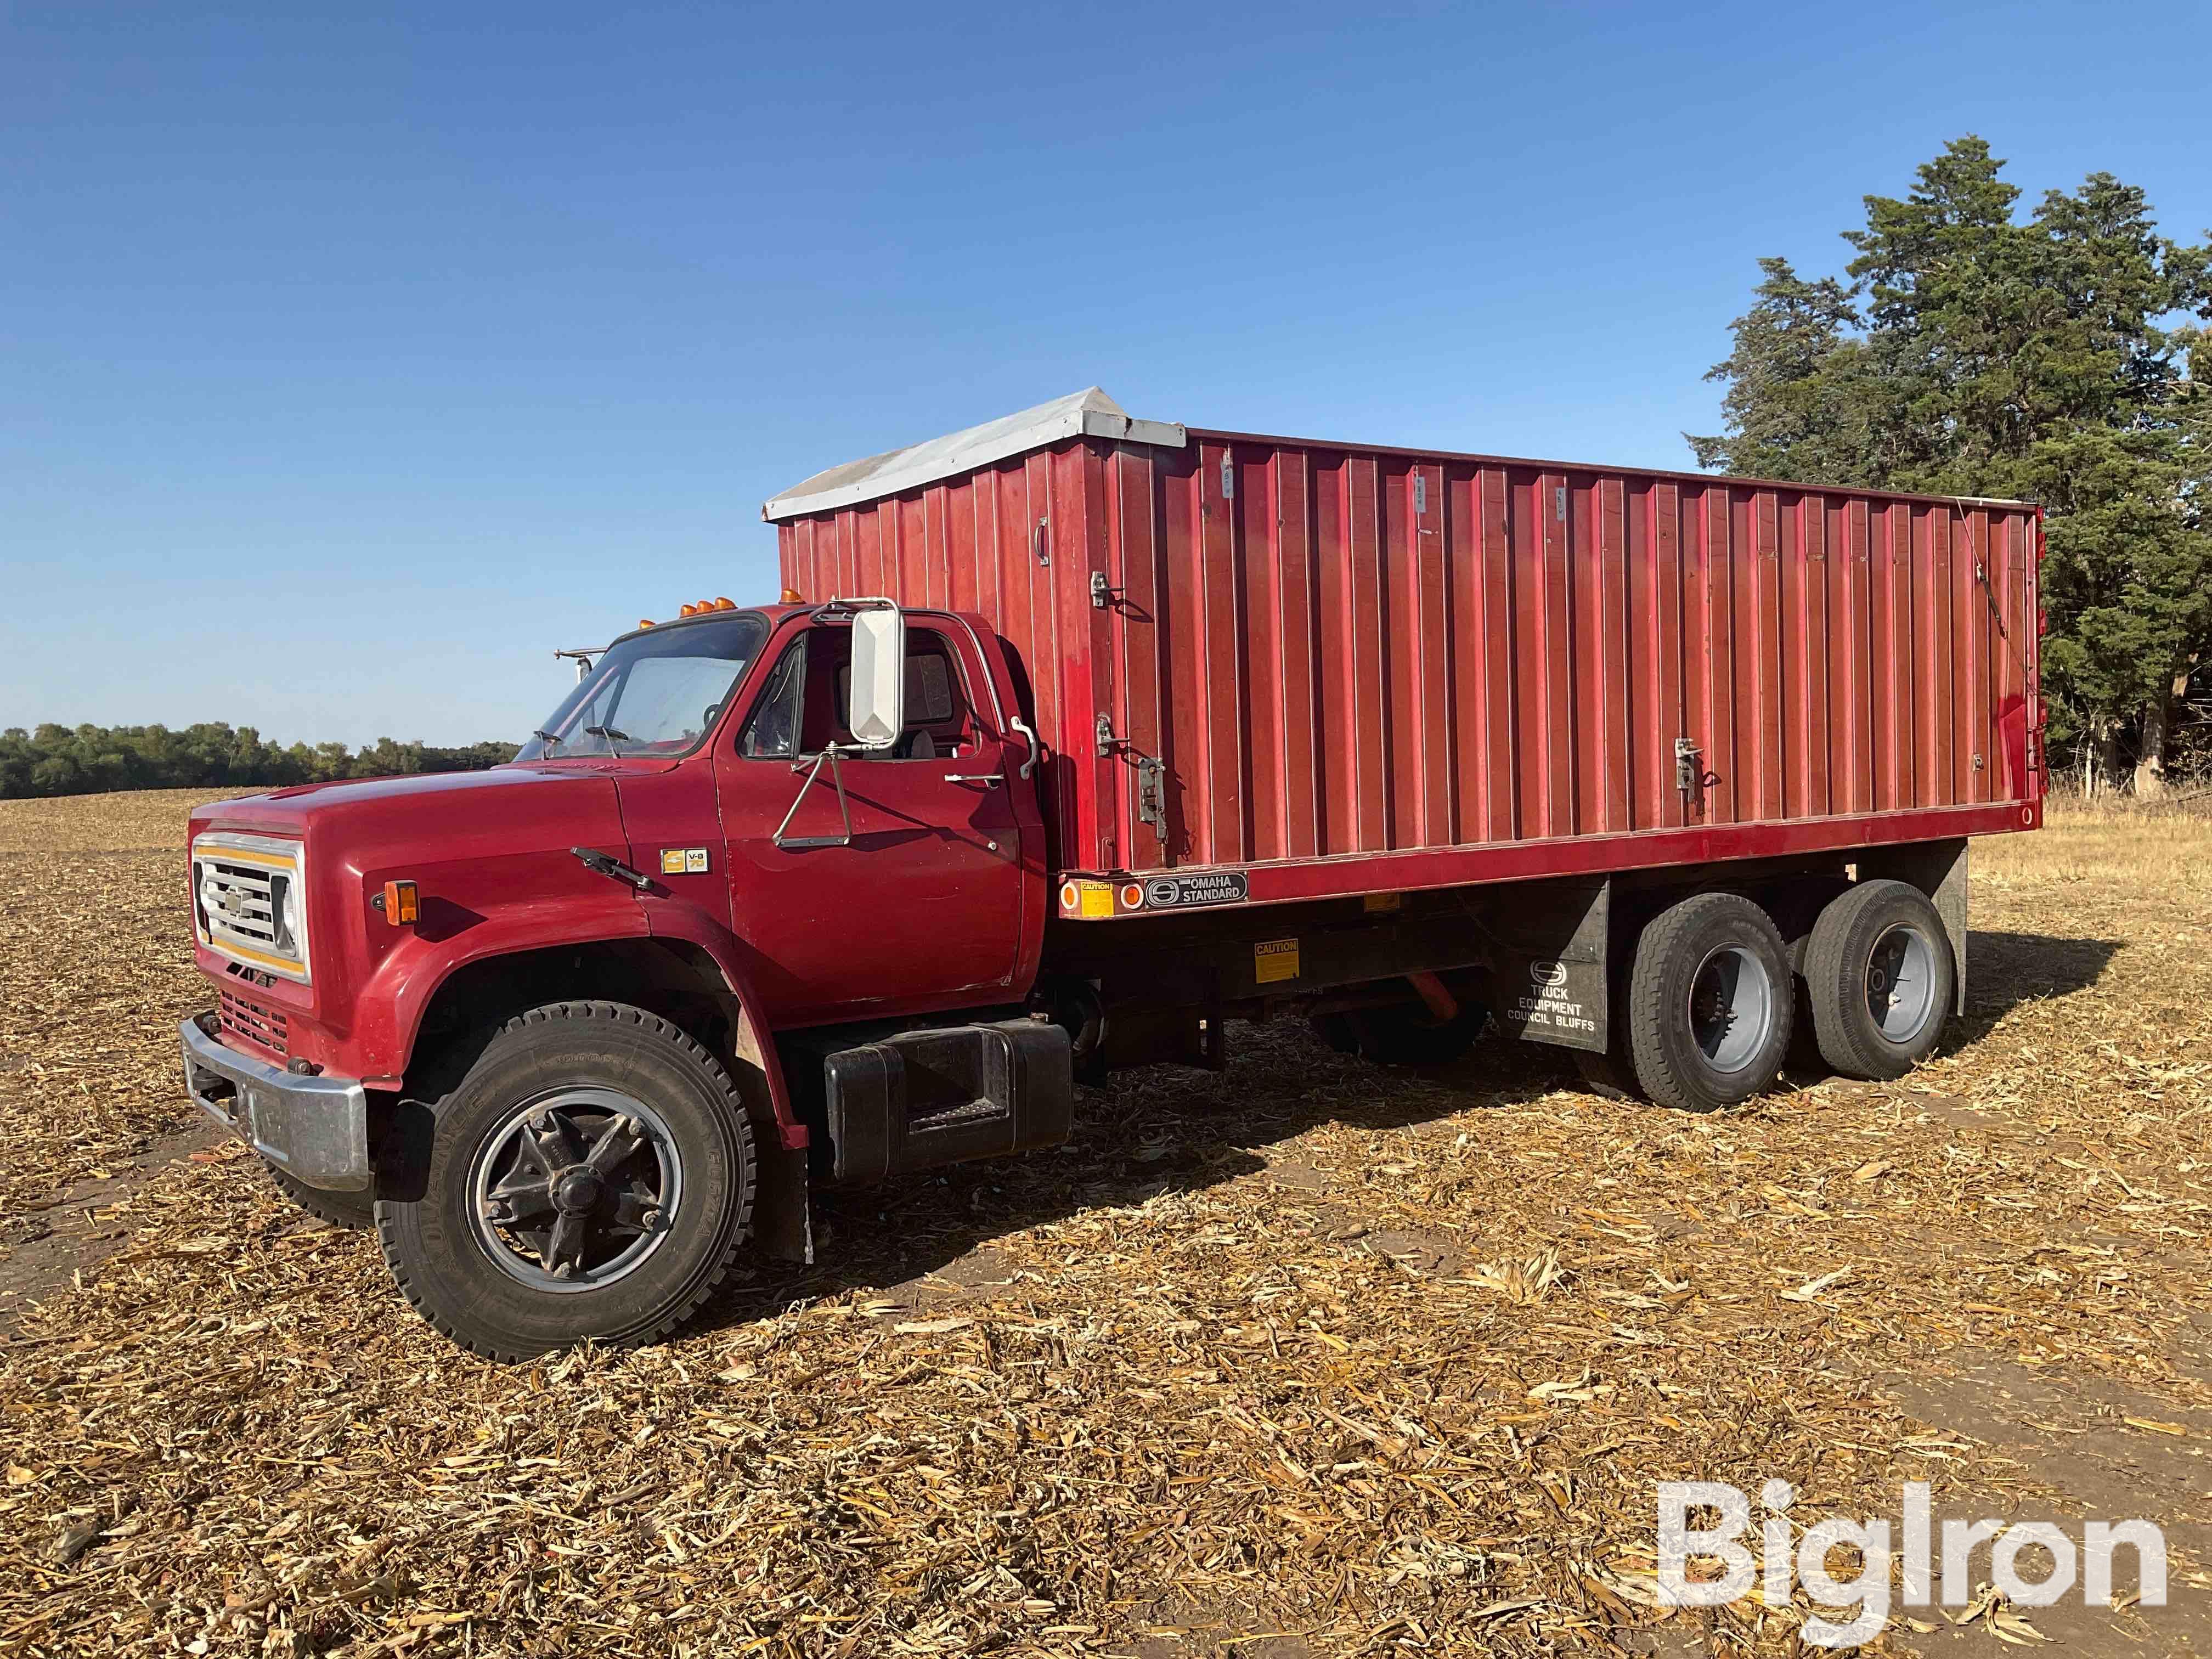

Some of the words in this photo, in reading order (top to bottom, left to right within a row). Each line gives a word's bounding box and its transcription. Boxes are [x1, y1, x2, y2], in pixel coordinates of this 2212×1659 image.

[1190, 876, 1232, 889] OMAHA
[1183, 887, 1240, 902] STANDARD
[1257, 941, 1296, 954] CAUTION
[1531, 984, 1568, 1000] TRUCK
[1519, 997, 1582, 1016] EQUIPMENT
[1508, 1009, 1550, 1025] COUNCIL
[1555, 1015, 1595, 1031] BLUFFS
